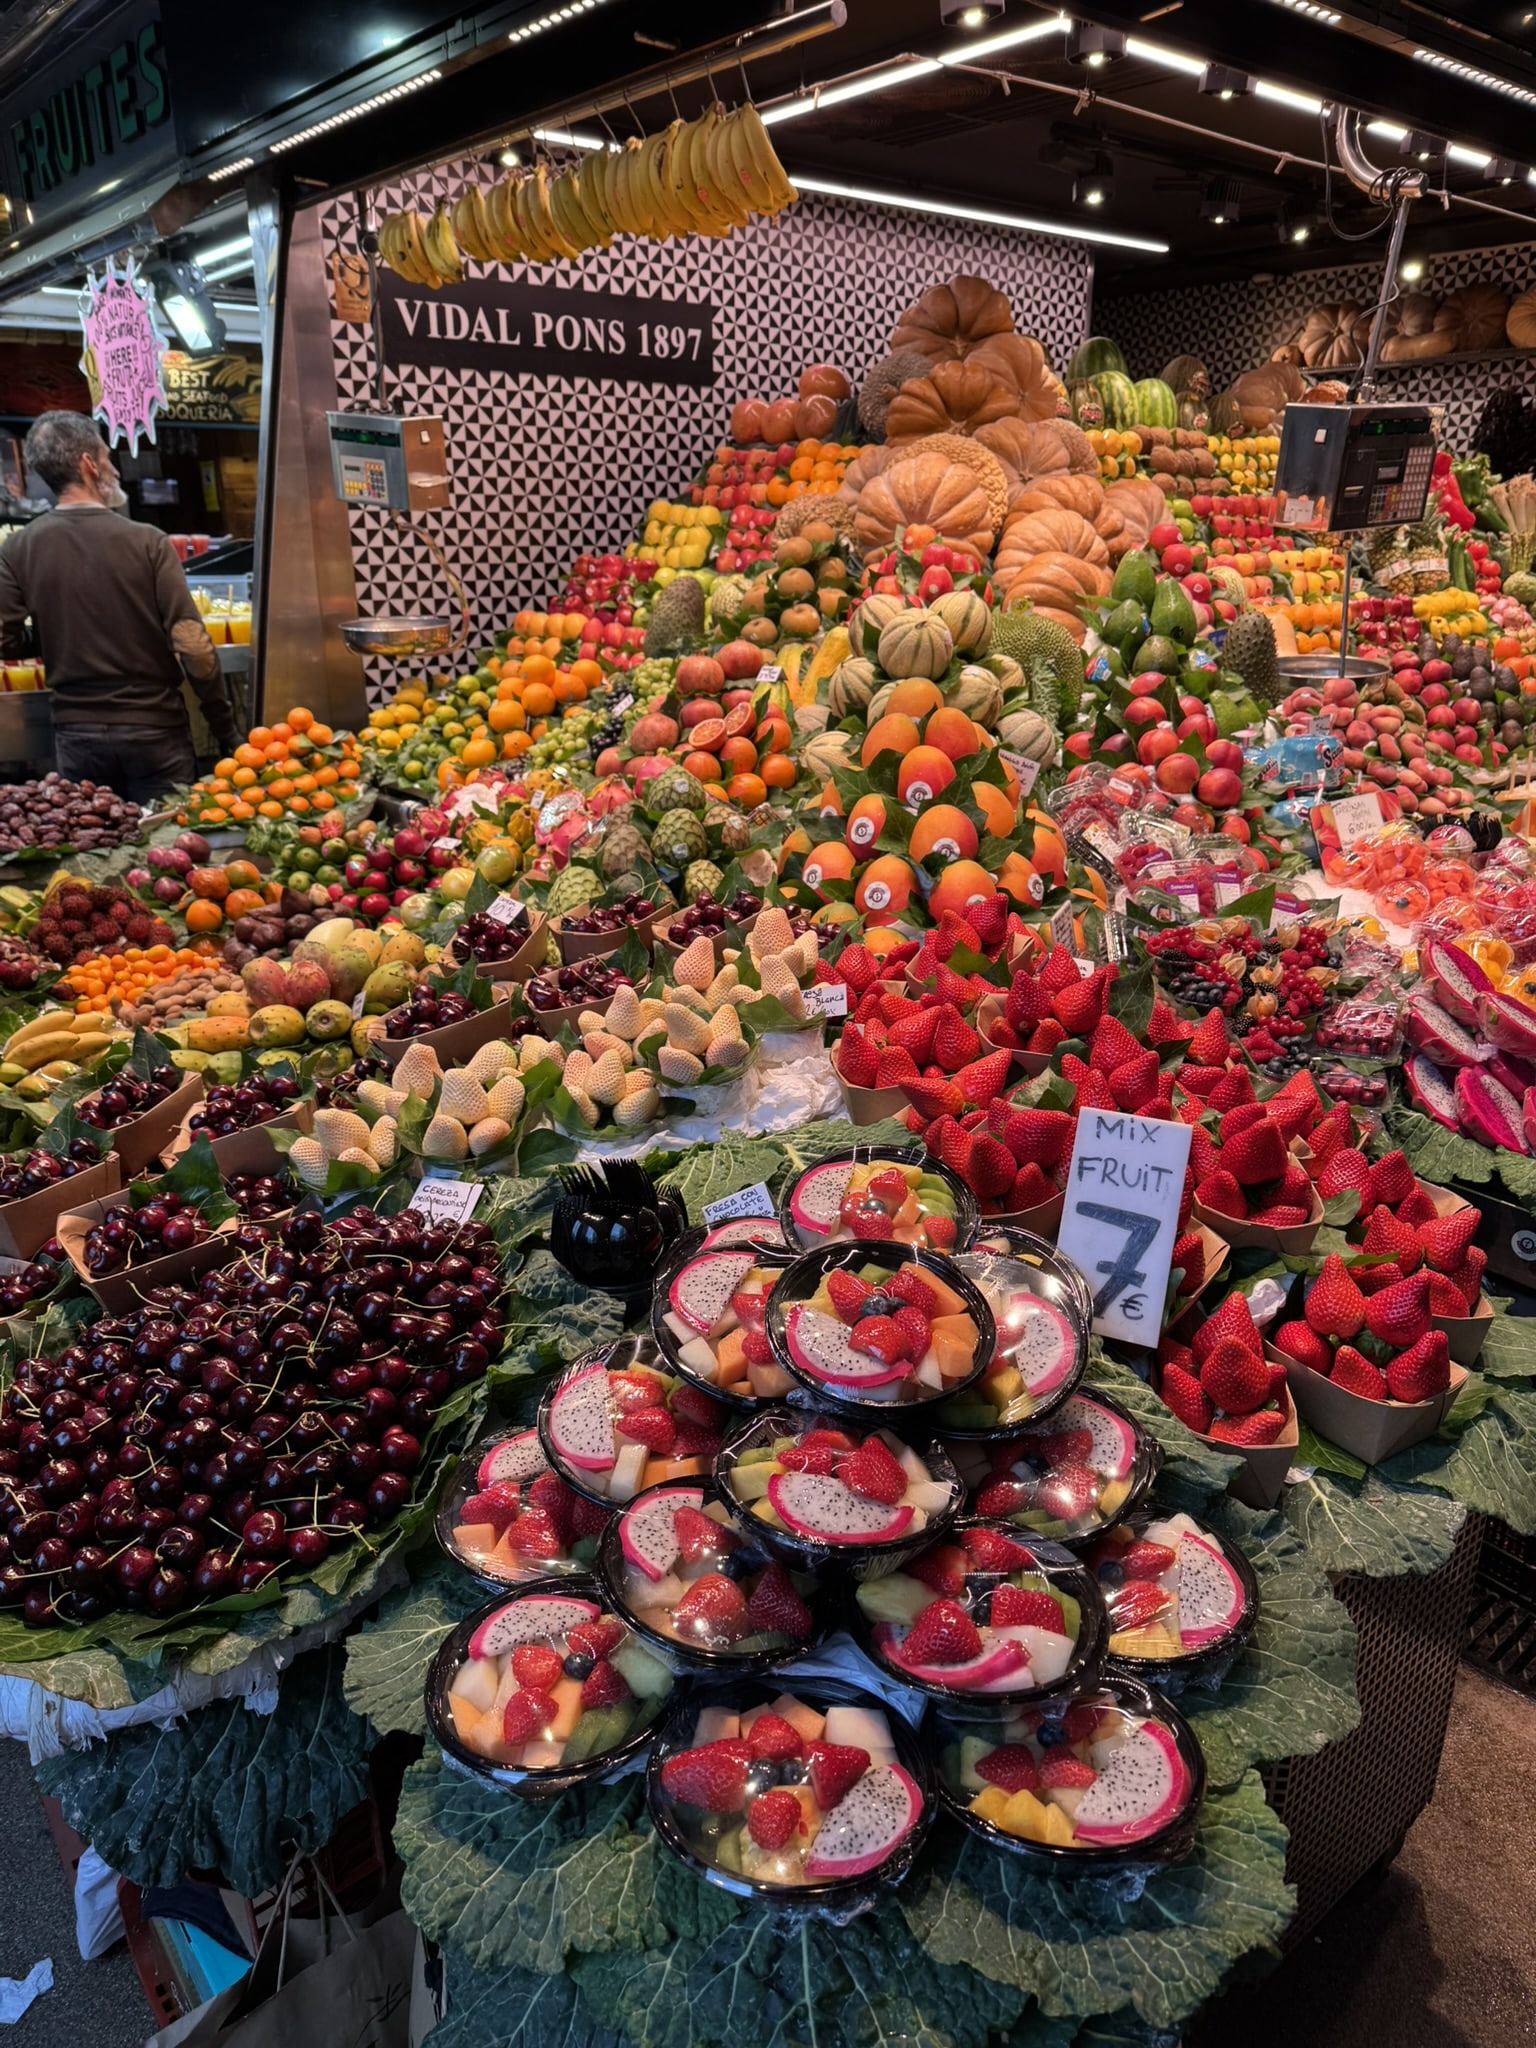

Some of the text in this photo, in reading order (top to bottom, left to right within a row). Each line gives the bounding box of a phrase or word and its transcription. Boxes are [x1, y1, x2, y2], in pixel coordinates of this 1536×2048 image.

[12, 22, 171, 200] FRUITES
[394, 297, 702, 361] VIDAL PONS 1897
[168, 369, 211, 388] BEST
[422, 1185, 459, 1198] CEREZA
[705, 1198, 737, 1216] FRESA
[741, 1188, 758, 1201] CON
[713, 1195, 765, 1221] CHOCOLATE
[1076, 1201, 1161, 1319] 7
[1119, 1293, 1148, 1320] €
